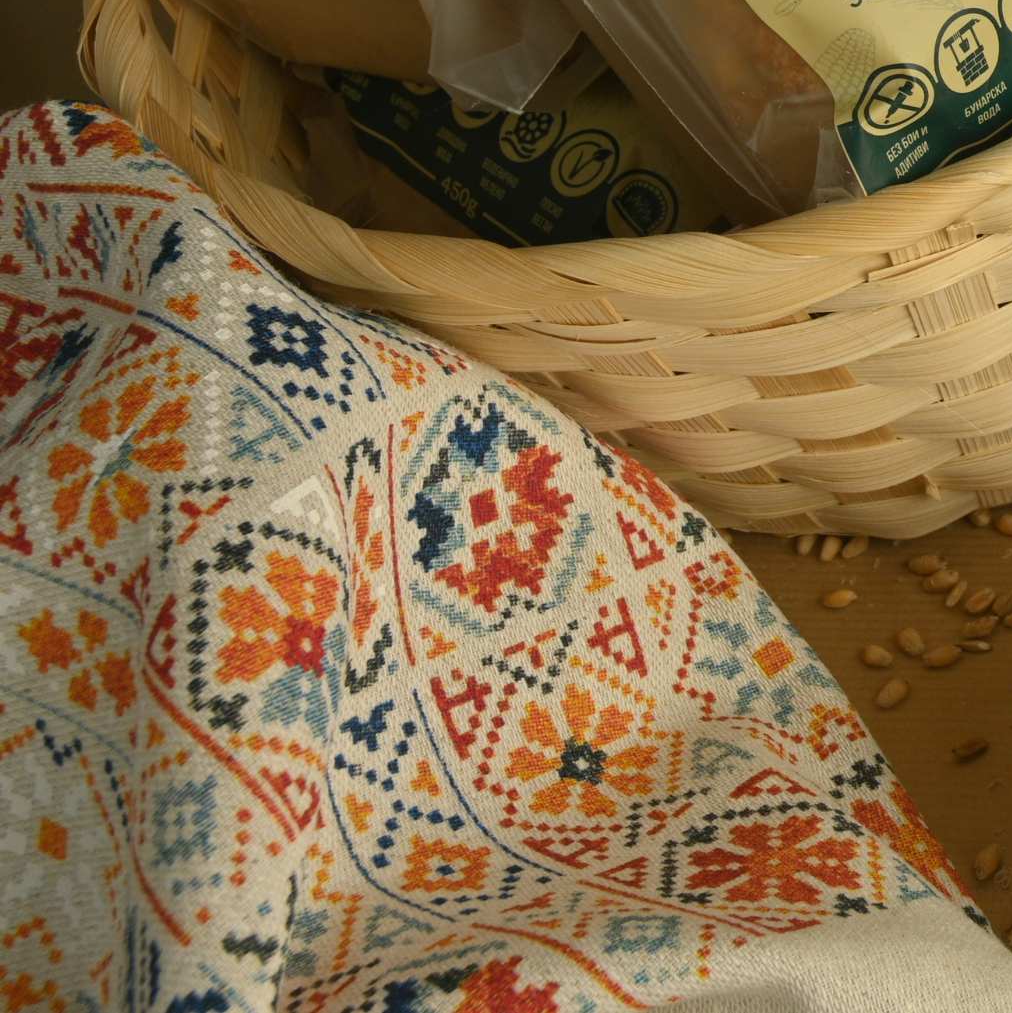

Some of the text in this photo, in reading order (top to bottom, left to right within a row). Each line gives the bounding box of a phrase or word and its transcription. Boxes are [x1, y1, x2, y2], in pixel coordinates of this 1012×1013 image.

[964, 80, 1008, 119] БУНАРСКА
[977, 103, 1002, 126] ВОДА
[885, 144, 904, 163] БЕЗ
[902, 129, 920, 152] БОИ
[894, 140, 930, 179] АДИТИВИ
[439, 174, 481, 220] 450g
